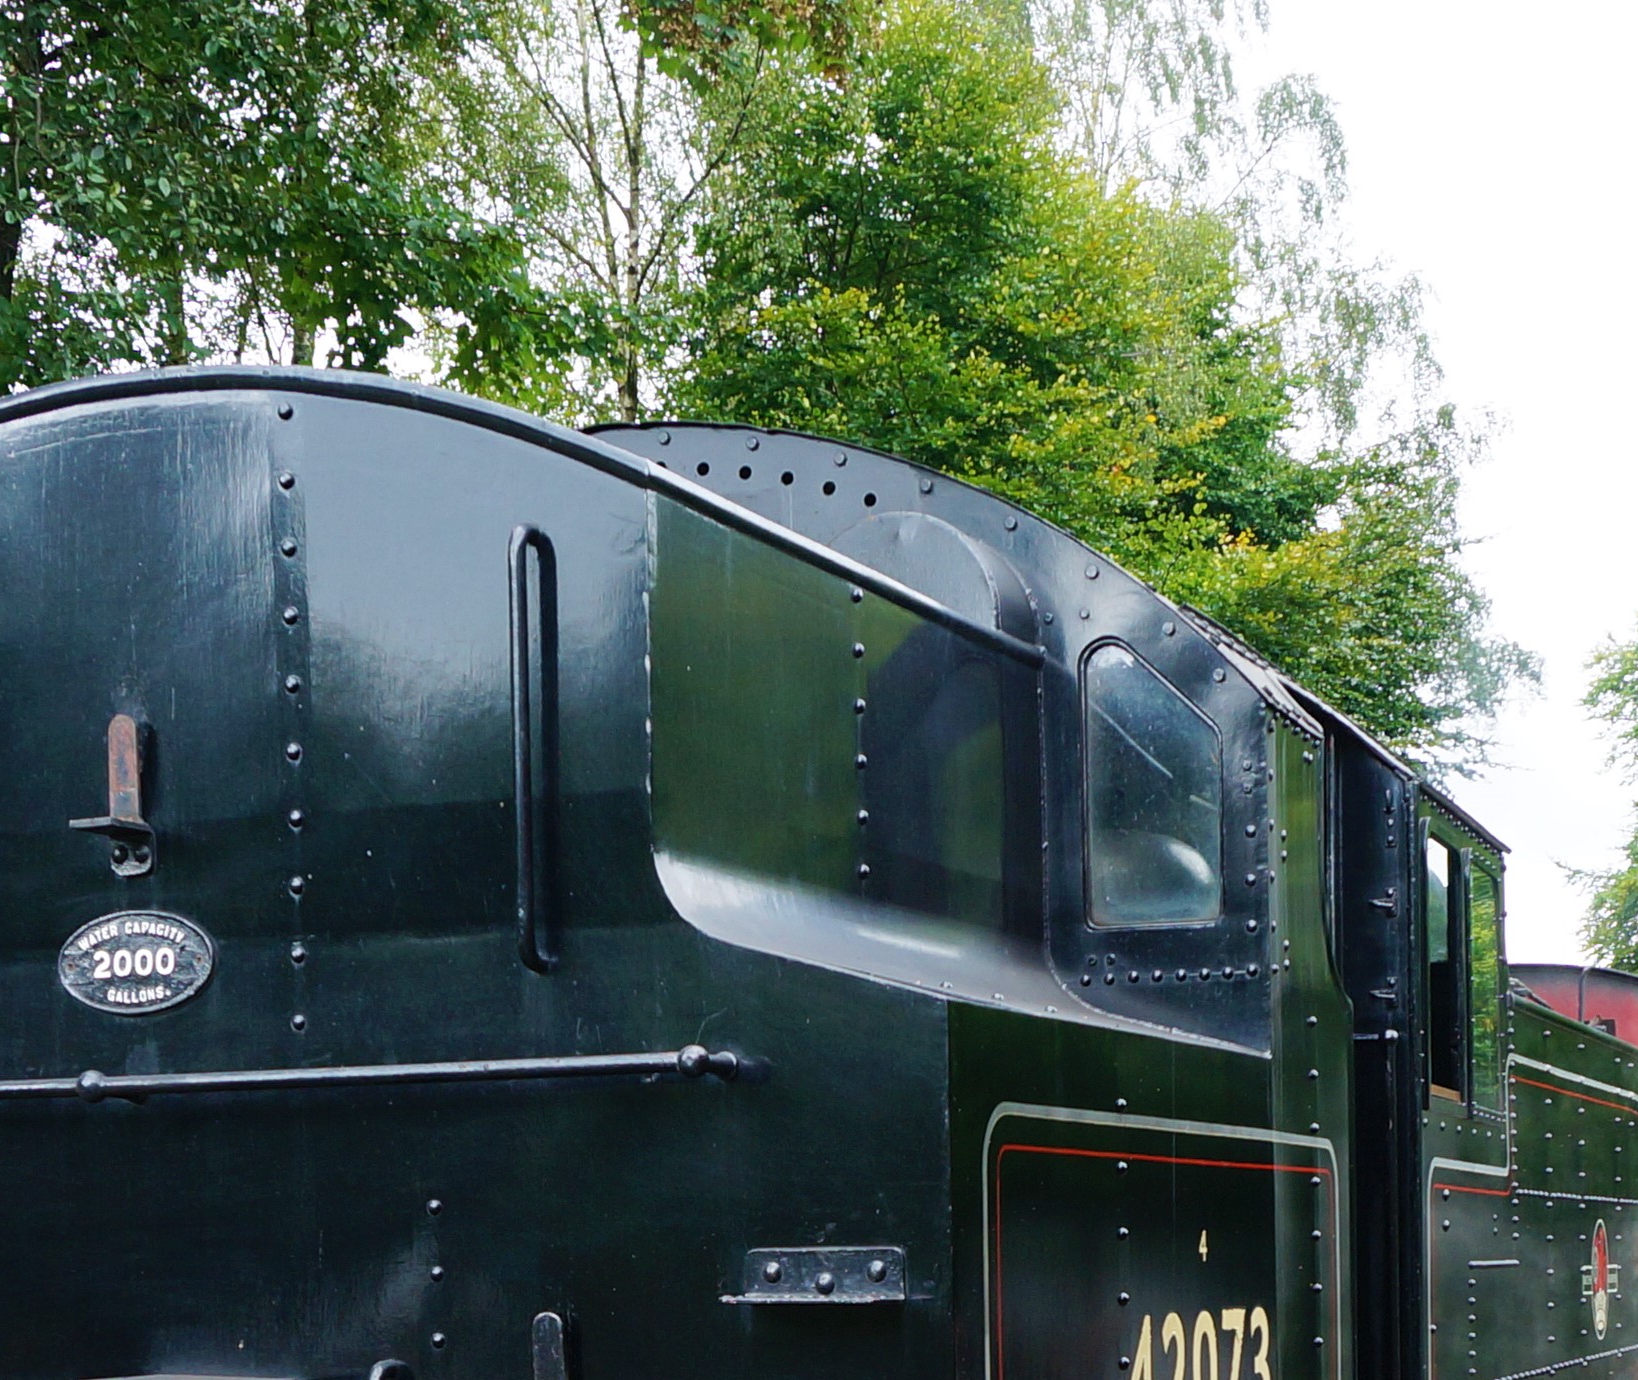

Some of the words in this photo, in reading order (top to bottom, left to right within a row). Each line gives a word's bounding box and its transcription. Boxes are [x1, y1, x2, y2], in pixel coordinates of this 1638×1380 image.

[77, 925, 118, 951] WATER
[125, 921, 186, 944] CAPACITY
[93, 946, 176, 979] 2000
[1198, 1229, 1209, 1263] 4
